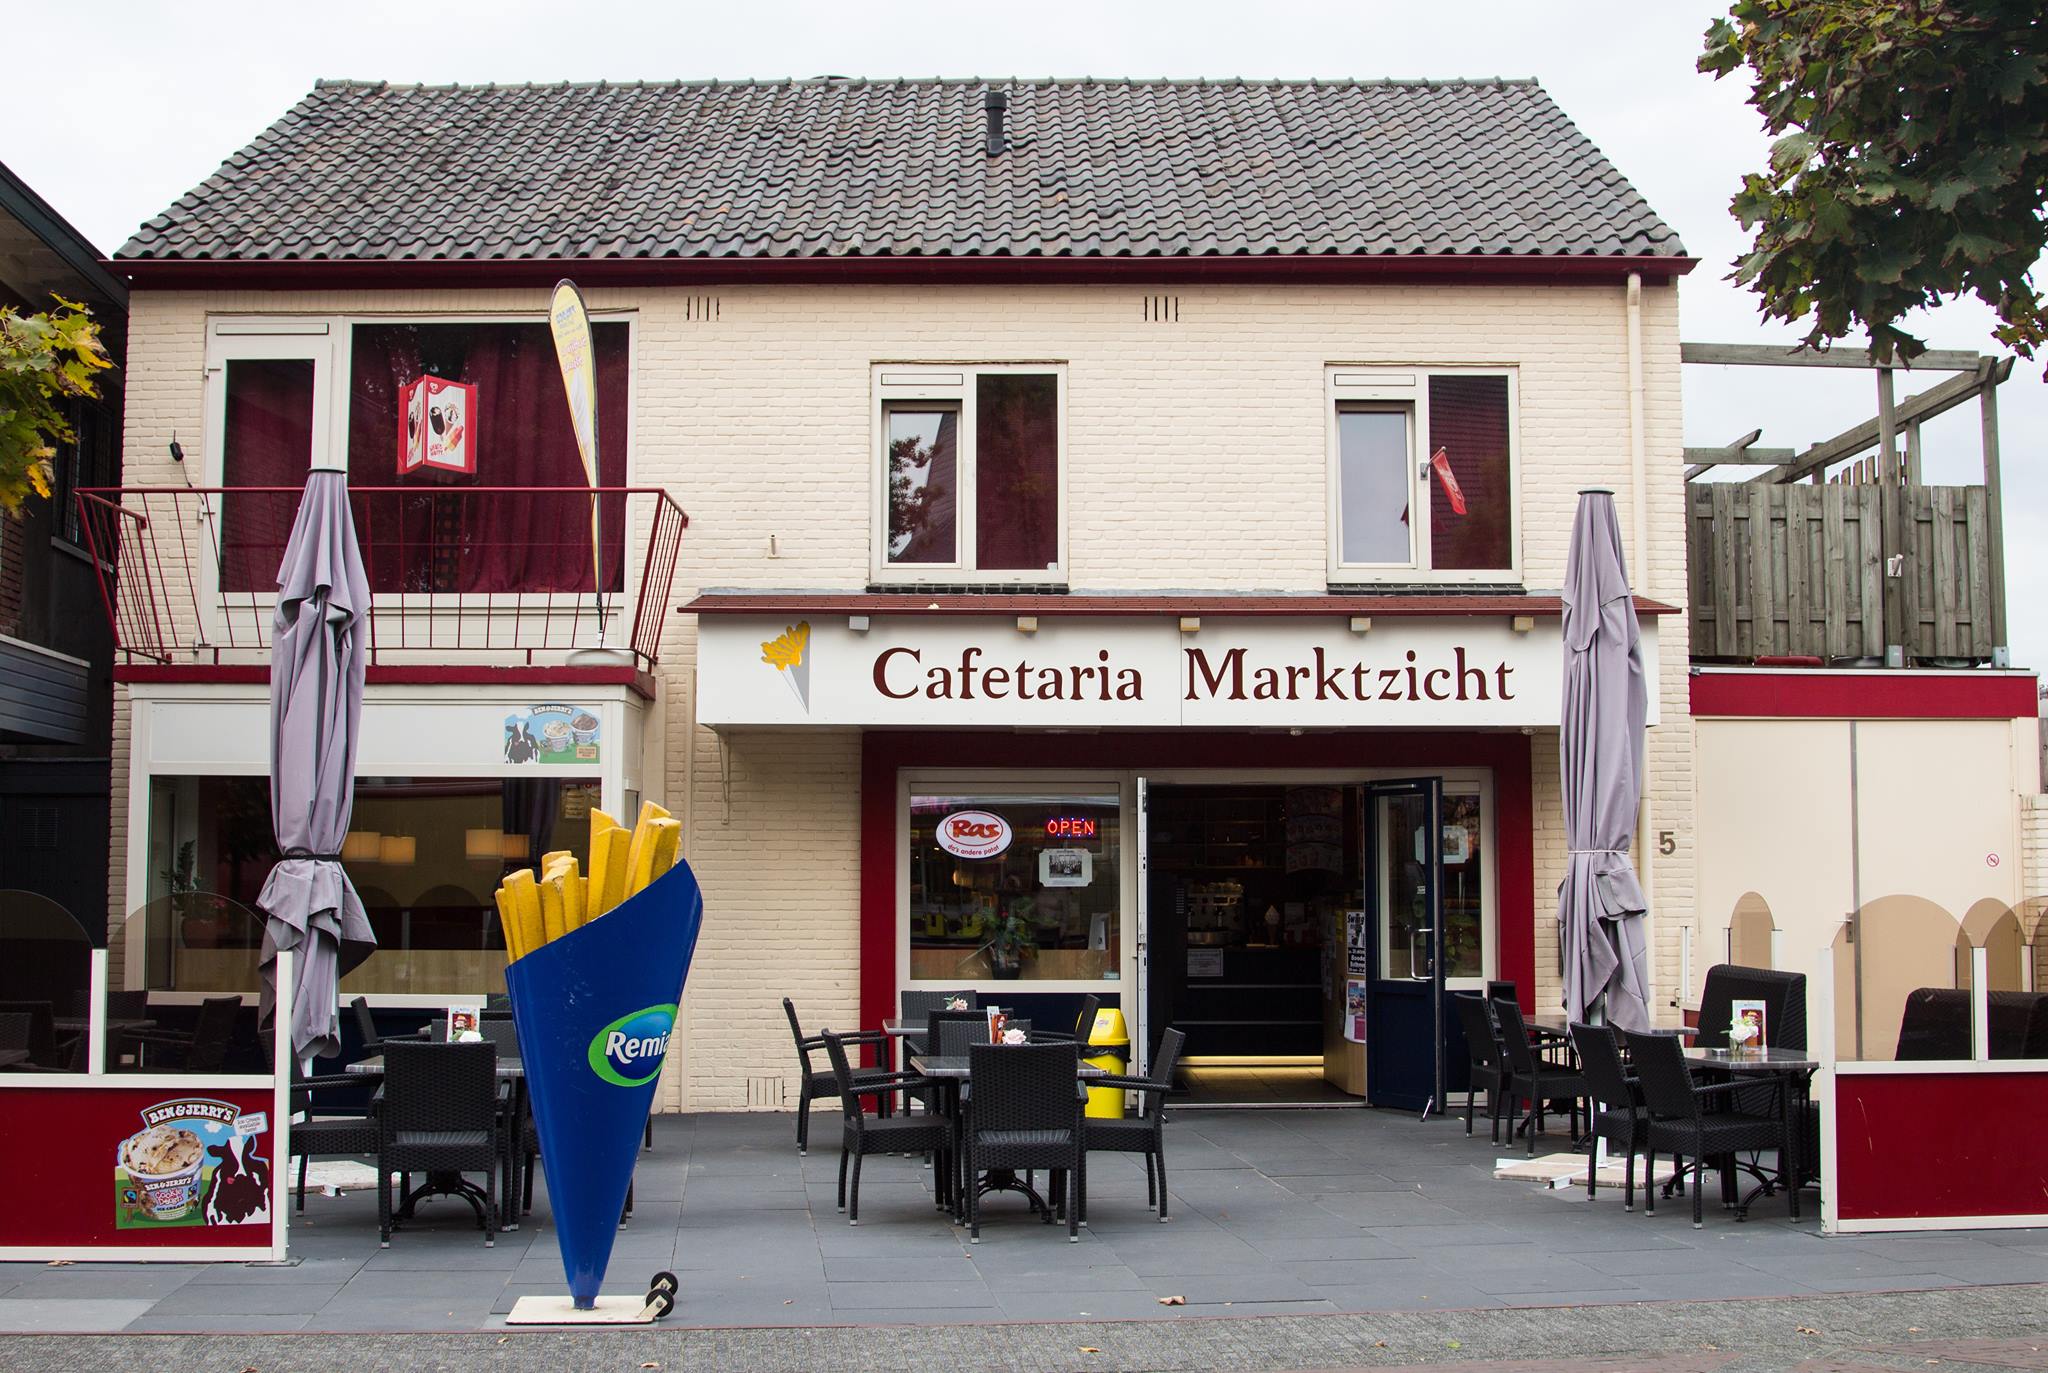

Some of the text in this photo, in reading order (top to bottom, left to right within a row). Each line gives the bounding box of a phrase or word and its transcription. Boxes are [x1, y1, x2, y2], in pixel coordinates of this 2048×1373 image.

[872, 646, 1515, 701] Cafetaria Marktzicht
[951, 820, 1000, 839] Ras
[1048, 820, 1095, 834] OPEN
[960, 848, 983, 856] andere
[983, 845, 1000, 856] patat
[1659, 831, 1676, 855] 5
